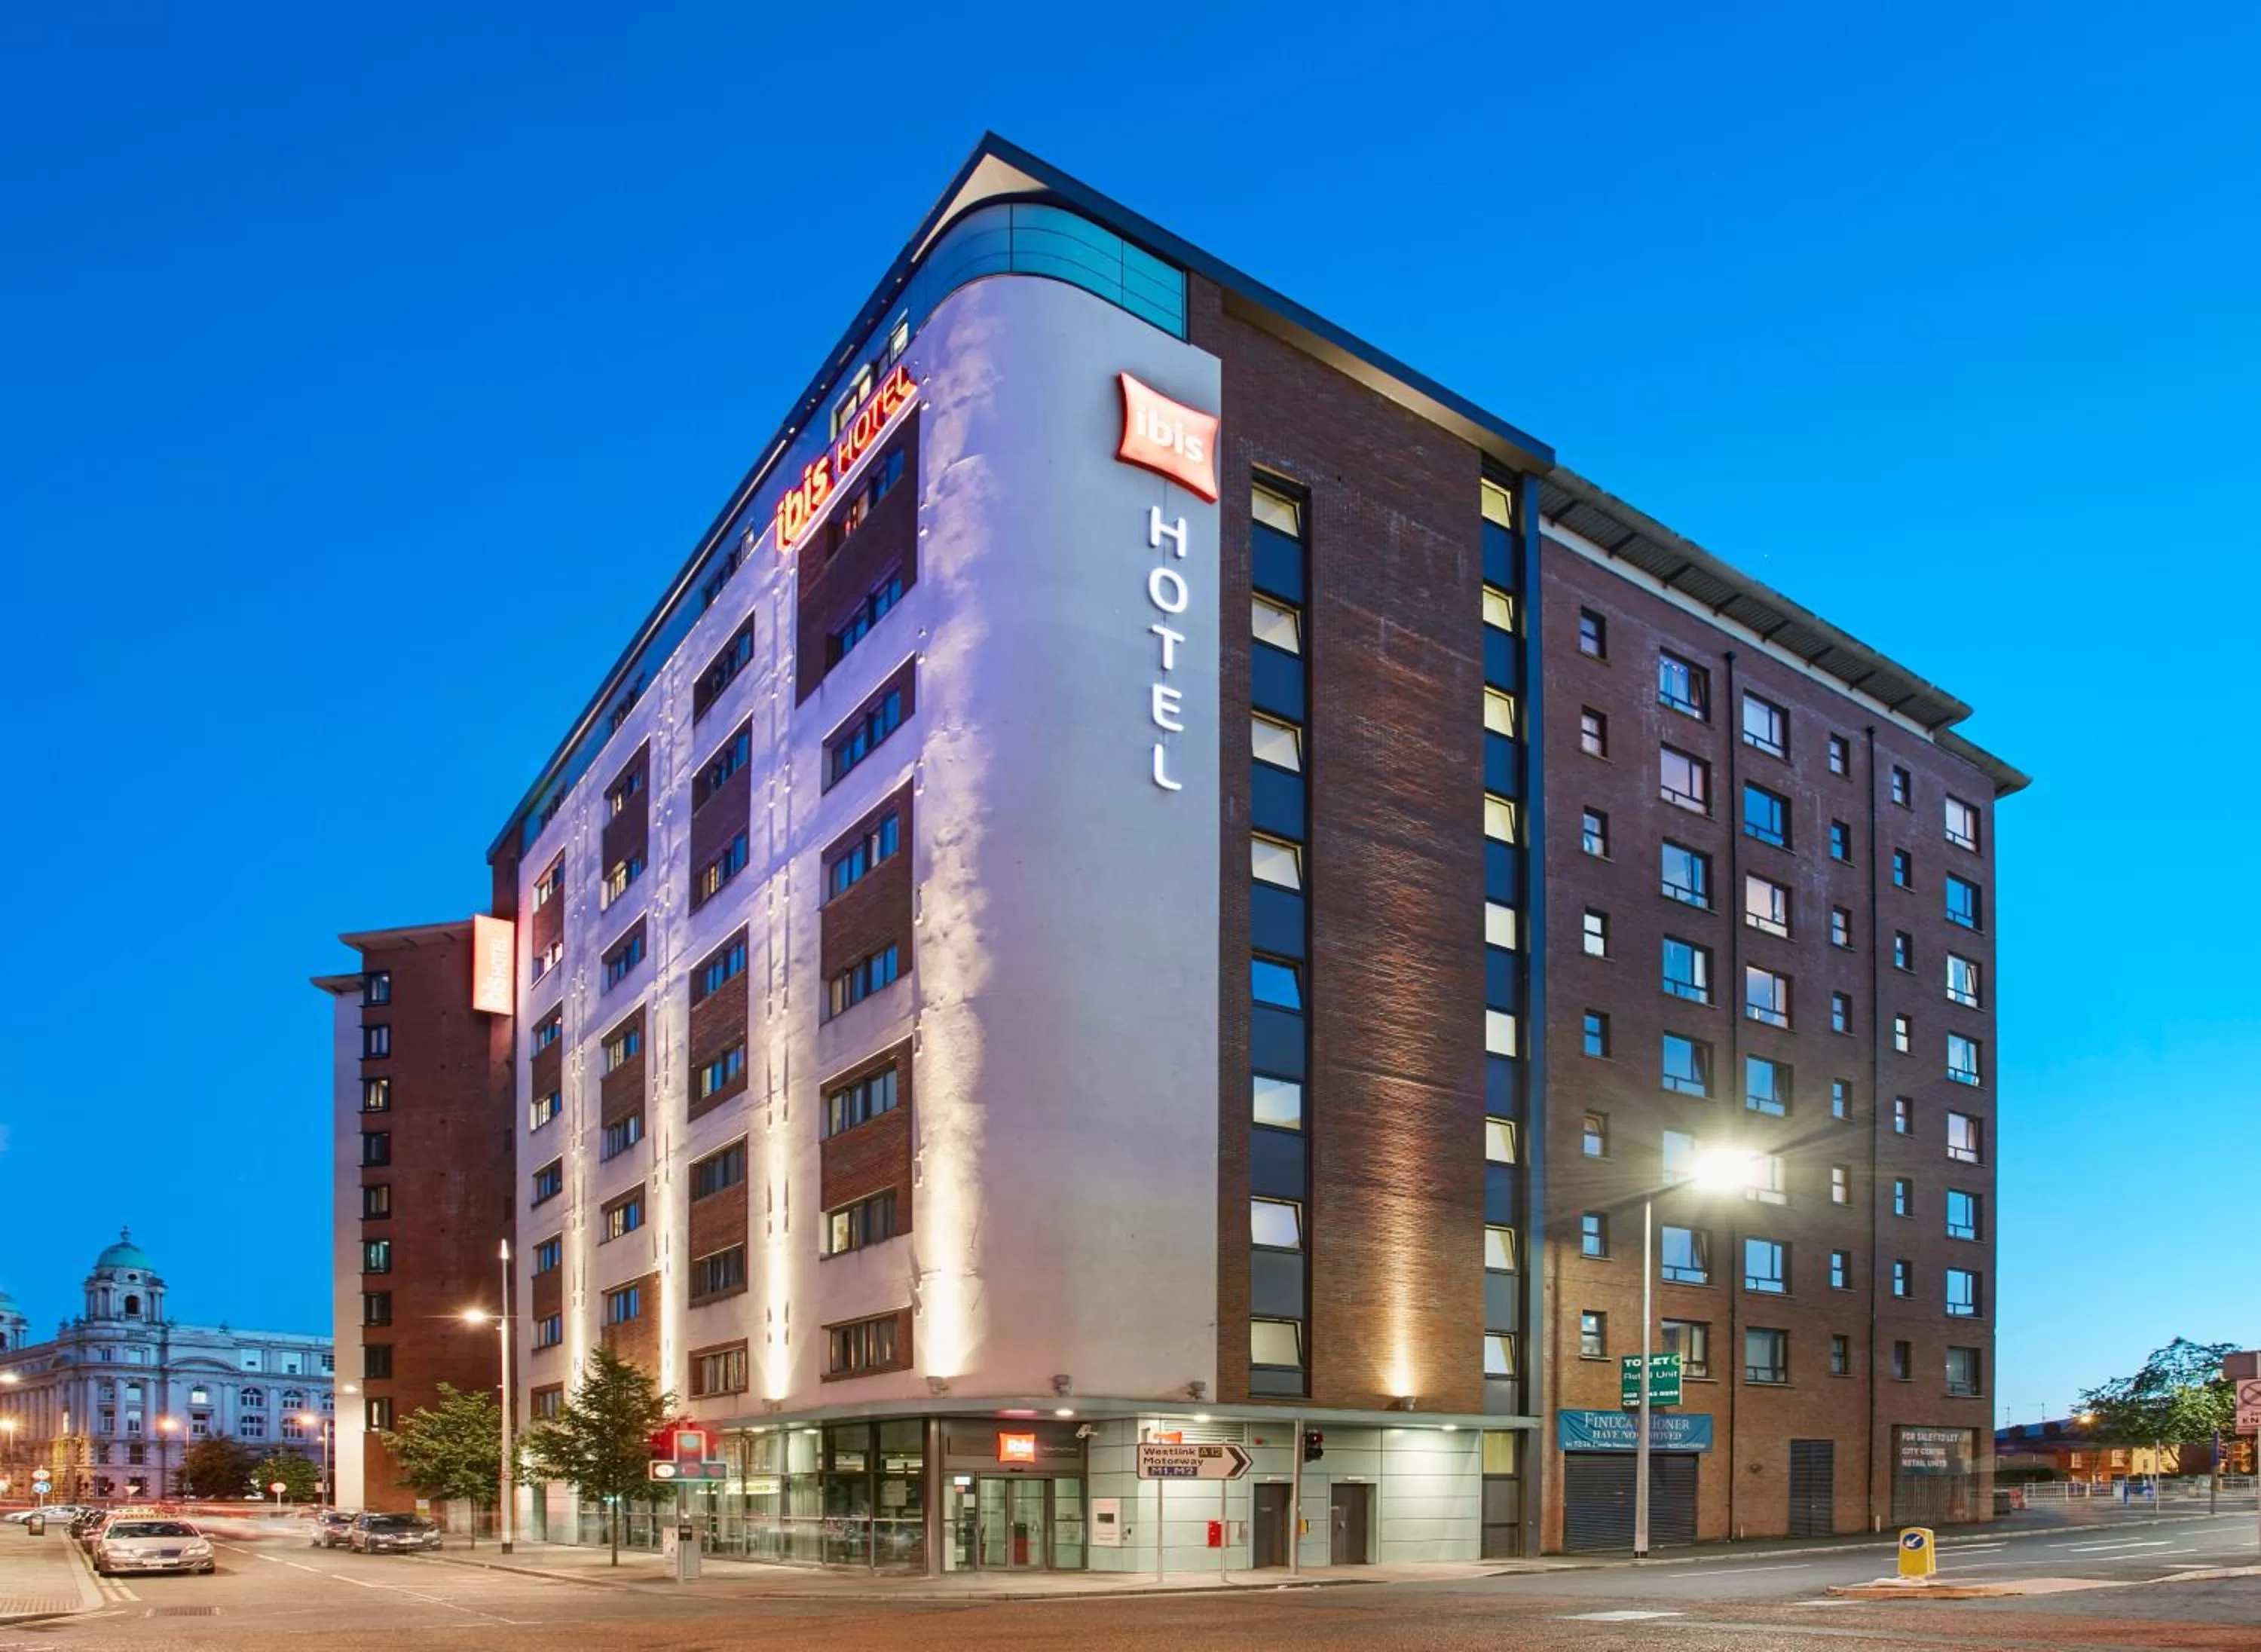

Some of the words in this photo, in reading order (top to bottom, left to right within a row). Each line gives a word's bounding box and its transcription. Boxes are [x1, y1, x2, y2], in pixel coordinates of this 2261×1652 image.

[1137, 407, 1203, 463] ibis
[776, 455, 831, 554] ibis
[836, 365, 914, 475] HOTEL
[1149, 506, 1189, 791] HOTEL
[1624, 1358, 1641, 1367] TO
[1656, 1370, 1678, 1378] Unit
[1592, 1430, 1618, 1439] HAVE
[1620, 1430, 1639, 1439] NO
[1143, 1447, 1195, 1455] Westlink
[1143, 1458, 1204, 1466] Motorway
